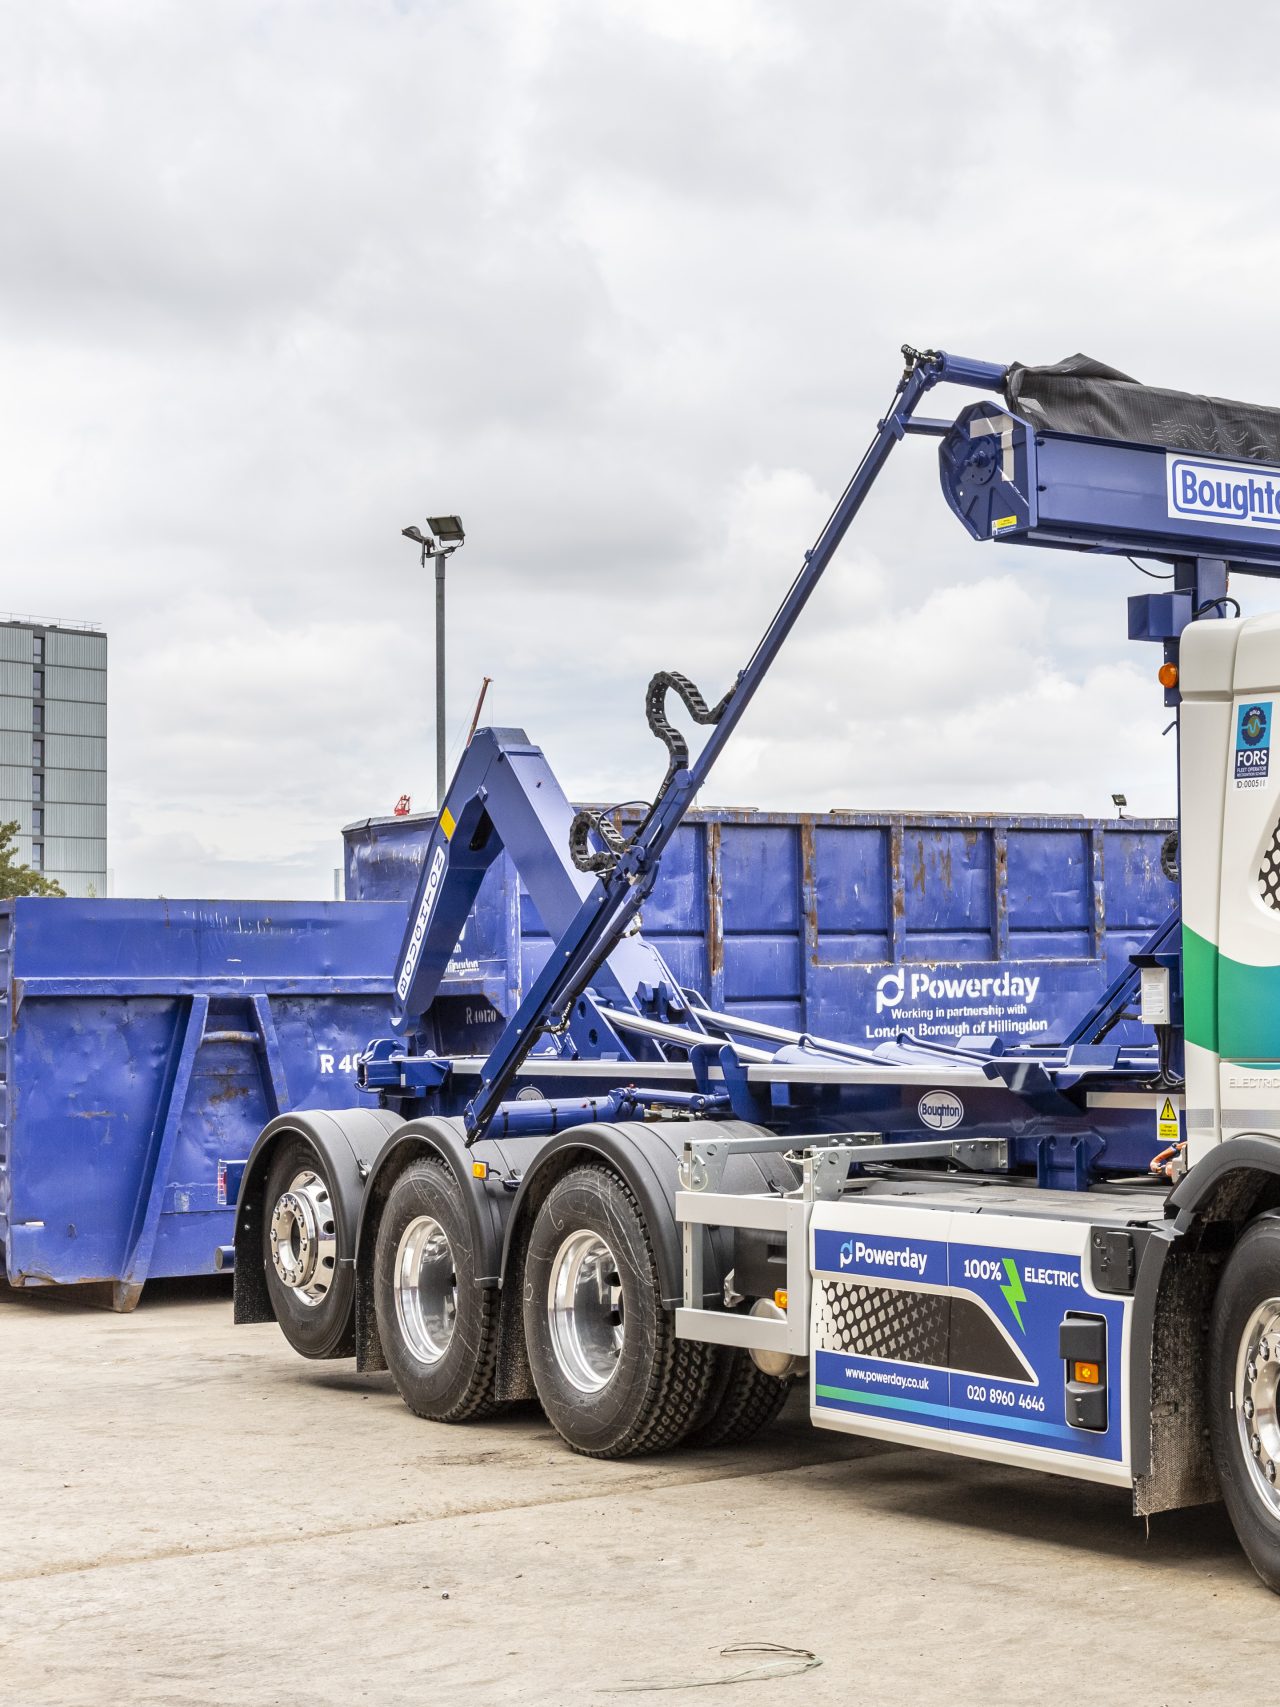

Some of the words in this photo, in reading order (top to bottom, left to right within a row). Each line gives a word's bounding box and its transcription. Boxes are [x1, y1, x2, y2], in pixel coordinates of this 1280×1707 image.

[1237, 750, 1267, 767] FORS
[400, 852, 442, 995] BOUGHTON
[911, 972, 1041, 1004] Powerday
[466, 1007, 473, 1025] R
[891, 1007, 933, 1020] Working
[936, 1006, 945, 1018] in
[947, 1004, 1005, 1020] partnership
[1007, 1003, 1027, 1015] with
[918, 1022, 971, 1038] Borough
[972, 1021, 986, 1034] of
[988, 1018, 1048, 1034] Hillingdon
[320, 1054, 335, 1074] R
[1229, 1078, 1280, 1089] ELECTRIC
[922, 1103, 960, 1118] Boughton
[855, 1241, 928, 1276] Powerday
[963, 1258, 1002, 1281] 100%
[1024, 1267, 1080, 1288] ELECTRIC
[845, 1367, 929, 1391] www.powerday.co.uk
[966, 1384, 987, 1402] 020
[989, 1387, 1015, 1408] 8960
[1018, 1392, 1045, 1412] 4646
